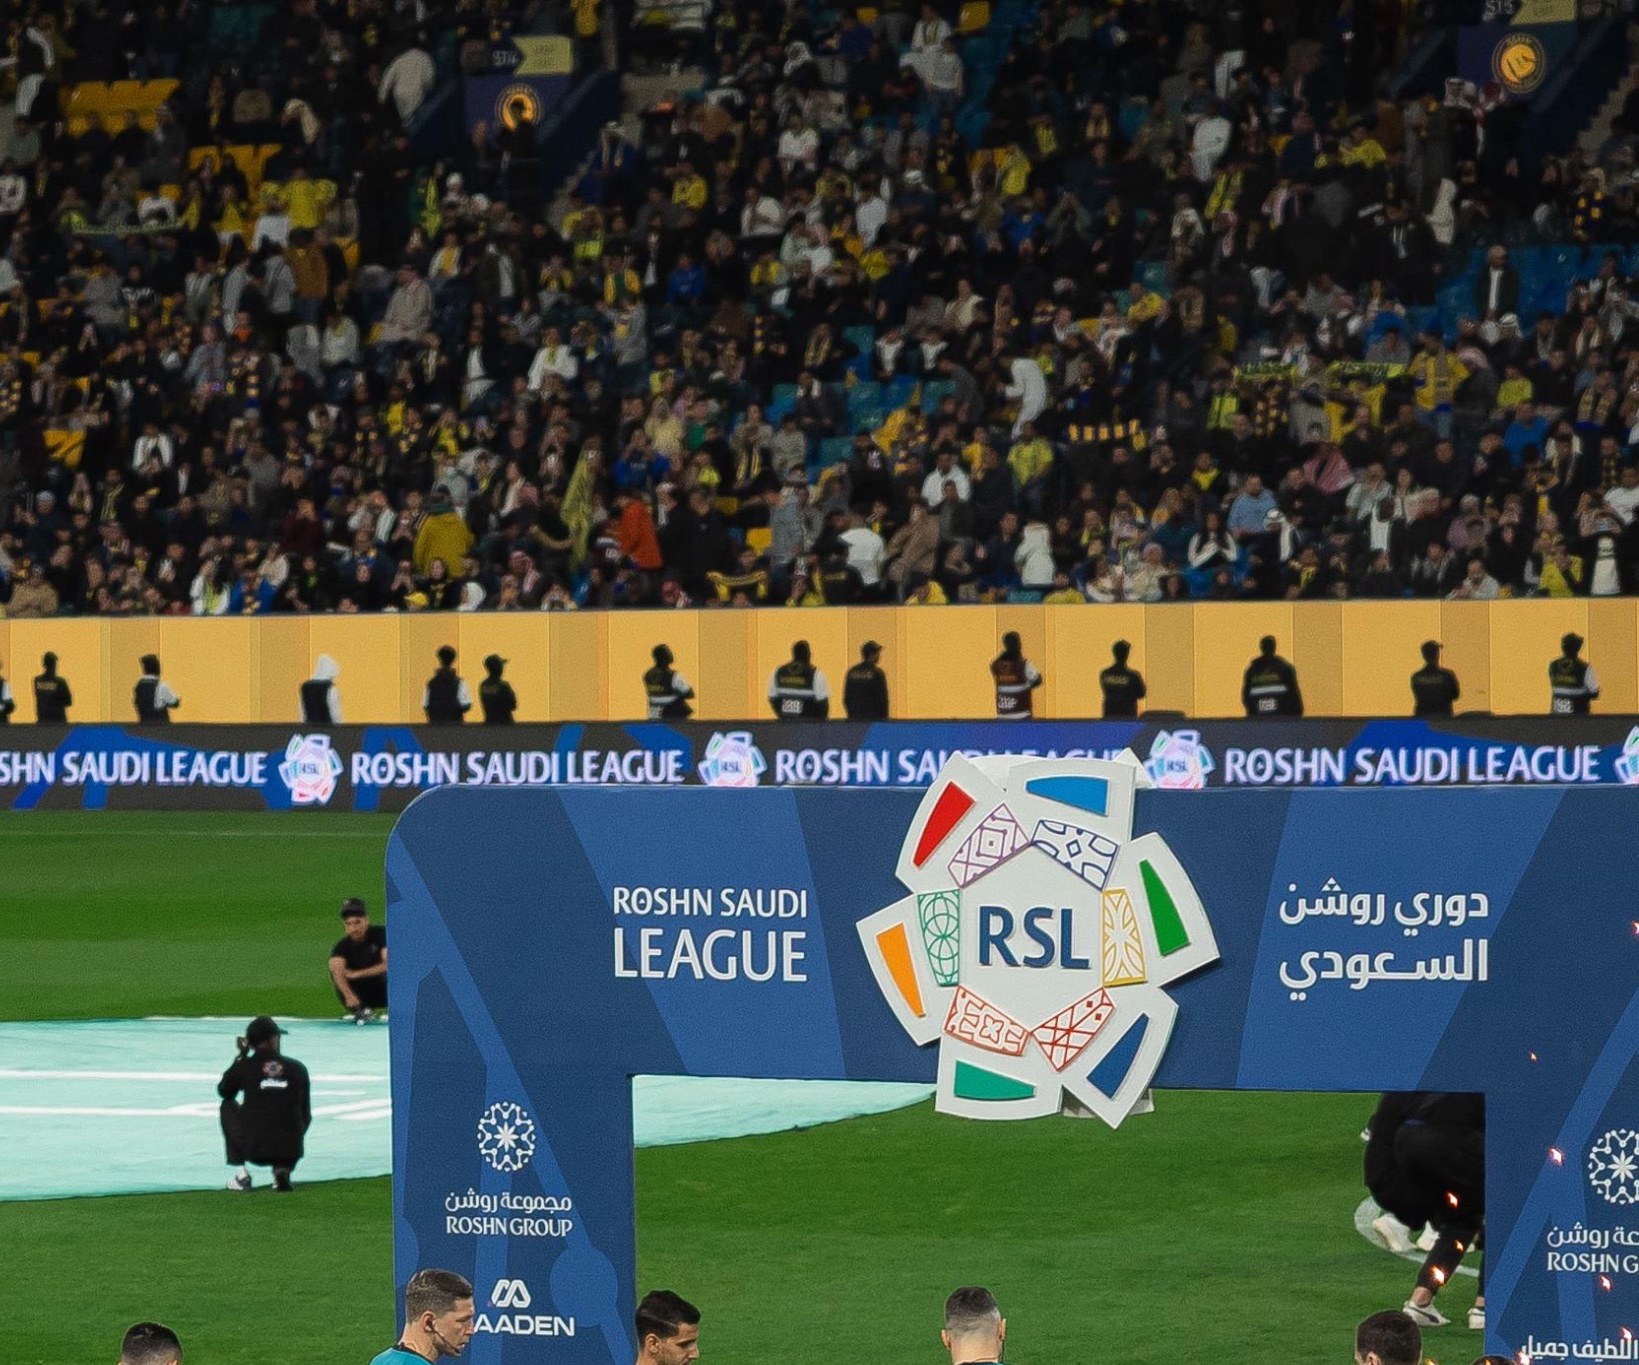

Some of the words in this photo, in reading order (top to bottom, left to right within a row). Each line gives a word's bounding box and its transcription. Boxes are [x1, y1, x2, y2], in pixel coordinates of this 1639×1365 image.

[63, 751, 149, 784] SAUDI
[157, 751, 268, 784] LEAGUE
[351, 751, 459, 786] ROSHN
[467, 751, 558, 784] SAUDI
[567, 749, 684, 784] LEAGUE
[775, 749, 888, 784] ROSHN
[1225, 748, 1345, 783] ROSHN
[1354, 747, 1457, 782] SAUDI
[1467, 745, 1600, 781] LEAGUE
[613, 887, 712, 916] ROSHN
[720, 888, 808, 918] SAUDI
[1280, 877, 1387, 928] روشن
[1393, 888, 1488, 934] دوري
[613, 927, 808, 982] LEAGUE
[978, 905, 1091, 969] RSL
[1280, 938, 1488, 1000] السعودي
[445, 1187, 499, 1213] روشن
[501, 1191, 573, 1213] مجموعة
[445, 1216, 507, 1235] ROSHN
[510, 1217, 573, 1237] GROUP
[1547, 1252, 1619, 1273] ROSHN
[474, 1314, 575, 1337] AADEN
